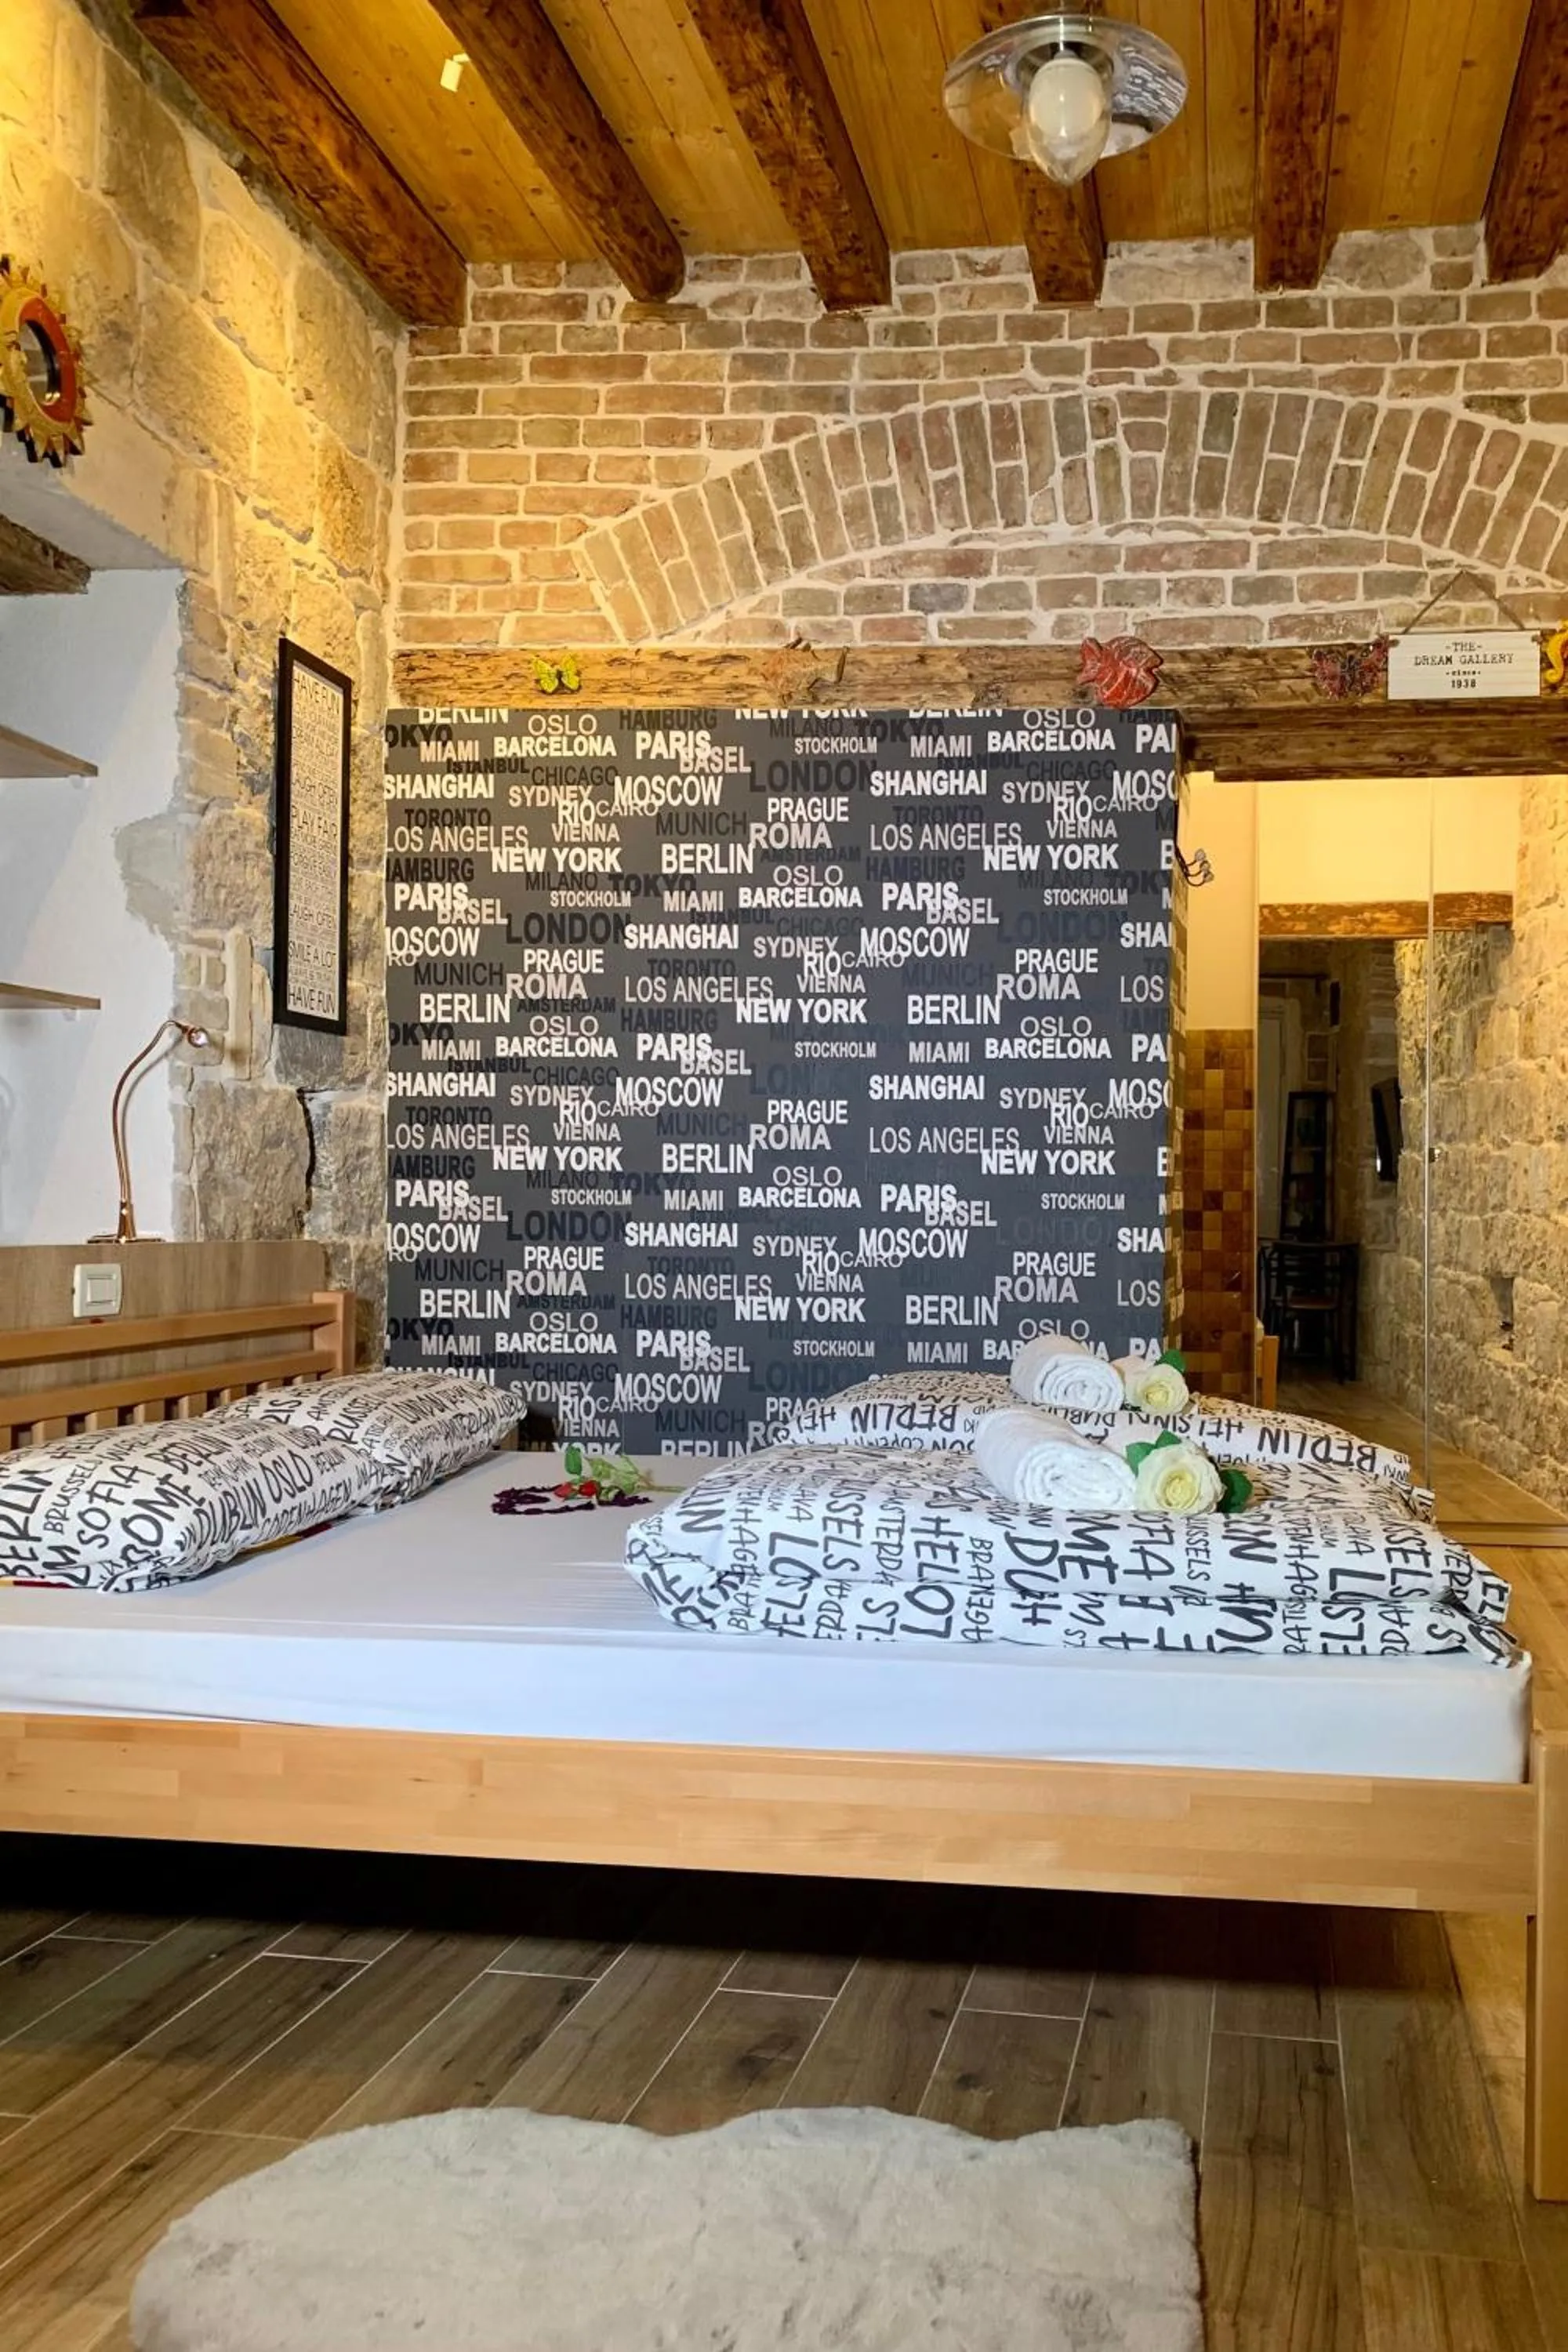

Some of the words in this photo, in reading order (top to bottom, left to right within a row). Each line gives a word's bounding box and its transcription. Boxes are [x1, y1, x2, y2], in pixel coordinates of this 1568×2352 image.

[1414, 655, 1453, 666] DREAM
[1459, 653, 1514, 664] GALLERY
[1451, 679, 1476, 688] 1938
[528, 714, 597, 735] OSLO
[1024, 708, 1095, 729] OSLO
[420, 740, 479, 760] MIAMI
[495, 736, 615, 756] BARCELONA
[637, 730, 711, 758] PARIS
[796, 736, 878, 752] STOCKHOLM
[911, 735, 972, 756] MIAMI
[989, 730, 1115, 750] BARCELONA
[680, 746, 751, 772] BASEL
[383, 775, 495, 798] SHANGHAI
[532, 765, 618, 786] CHICAGO
[872, 770, 988, 793] SHANGHAI
[509, 786, 591, 806] SYDNEY
[615, 777, 722, 804] MOSCOW
[1003, 781, 1089, 801] SYDNEY
[558, 802, 596, 824] RIO
[597, 800, 658, 815] CAIRO
[768, 796, 850, 819] PRAGUE
[1054, 798, 1094, 820] RIO
[1094, 797, 1158, 811] CAIRO
[405, 808, 490, 827] TORONTO
[656, 812, 746, 834] MUNICH
[1047, 819, 1117, 837] VIENNA
[552, 823, 619, 841] VIENNA
[751, 822, 833, 845] ROMA
[872, 824, 916, 848] LOS
[922, 823, 1023, 848] ANGELES
[492, 848, 545, 871] NEW
[553, 848, 622, 871] YORK
[662, 844, 753, 872] BERLIN
[985, 844, 1040, 868] NEW
[1047, 844, 1120, 868] YORK
[525, 872, 597, 890] MILANO
[773, 864, 843, 885] OSLO
[395, 884, 468, 911] PARIS
[550, 891, 631, 906] STOCKHOLM
[663, 889, 722, 910] MIAMI
[739, 885, 862, 906] BARCELONA
[883, 880, 959, 909] PARIS
[1045, 887, 1129, 904] STOCKHOLM
[437, 899, 507, 925] BASEL
[927, 897, 1000, 924] BASEL
[625, 924, 739, 948] SHANGHAI
[753, 935, 837, 956] SYDNEY
[860, 927, 969, 956] MOSCOW
[288, 940, 311, 963] SMILE
[313, 947, 320, 964] A
[321, 949, 336, 967] LOT
[524, 949, 604, 972] PRAGUE
[803, 952, 841, 975] RIO
[842, 951, 905, 966] CAIRO
[1017, 947, 1099, 971] PRAGUE
[414, 964, 503, 985] MUNICH
[507, 973, 587, 997] ROMA
[797, 973, 865, 991] VIENNA
[999, 972, 1082, 997] ROMA
[625, 976, 668, 1000] LOS
[674, 976, 773, 1000] ANGELES
[1122, 975, 1166, 1000] LOS
[288, 984, 314, 1010] HAVE
[318, 989, 336, 1014] FUN
[420, 994, 509, 1023] BERLIN
[517, 997, 615, 1011] AMSTERDAM
[735, 997, 789, 1021] NEW
[797, 997, 867, 1022] YORK
[908, 994, 1000, 1023] BERLIN
[528, 1015, 597, 1036] OSLO
[621, 1007, 717, 1031] HAMBURG
[1021, 1015, 1092, 1037] OSLO
[422, 1039, 480, 1060] MIAMI
[495, 1036, 615, 1057] BARCELONA
[636, 1032, 710, 1061] PARIS
[794, 1040, 877, 1056] STOCKHOLM
[909, 1040, 969, 1061] MIAMI
[986, 1036, 1111, 1058] BARCELONA
[679, 1049, 750, 1075] BASEL
[384, 1073, 495, 1097] SHANGHAI
[532, 1065, 618, 1086] CHICAGO
[870, 1075, 985, 1098] SHANGHAI
[509, 1085, 591, 1105] SYDNEY
[615, 1077, 721, 1106] MOSCOW
[1000, 1087, 1085, 1108] SYDNEY
[558, 1102, 596, 1124] RIO
[597, 1101, 658, 1116] CAIRO
[767, 1098, 848, 1123] PRAGUE
[1051, 1104, 1090, 1127] RIO
[1091, 1103, 1154, 1118] CAIRO
[553, 1123, 619, 1141] VIENNA
[750, 1123, 831, 1148] ROMA
[869, 1127, 913, 1152] LOS
[920, 1127, 1020, 1152] ANGELES
[1044, 1125, 1114, 1143] VIENNA
[492, 1146, 546, 1169] NEW
[553, 1147, 622, 1170] YORK
[662, 1144, 752, 1173] BERLIN
[982, 1149, 1036, 1172] NEW
[1044, 1149, 1116, 1174] YORK
[771, 1166, 841, 1187] OSLO
[396, 1180, 469, 1207] PARIS
[551, 1189, 631, 1204] STOCKHOLM
[662, 1189, 721, 1210] MIAMI
[738, 1186, 860, 1207] BARCELONA
[881, 1183, 956, 1211] PARIS
[1042, 1192, 1125, 1209] STOCKHOLM
[438, 1196, 507, 1221] BASEL
[924, 1200, 996, 1226] BASEL
[625, 1223, 738, 1247] SHANGHAI
[751, 1235, 835, 1256] SYDNEY
[858, 1229, 967, 1258] MOSCOW
[524, 1246, 604, 1269] PRAGUE
[801, 1253, 840, 1275] RIO
[840, 1252, 902, 1267] CAIRO
[1014, 1250, 1096, 1275] PRAGUE
[416, 1260, 503, 1281] MUNICH
[507, 1270, 587, 1294] ROMA
[625, 1275, 667, 1298] LOS
[673, 1275, 771, 1299] ANGELES
[795, 1274, 863, 1291] VIENNA
[996, 1276, 1079, 1300] ROMA
[1118, 1280, 1162, 1304] LOS
[422, 1290, 510, 1318] BERLIN
[735, 1297, 788, 1319] NEW
[796, 1298, 865, 1321] YORK
[906, 1295, 997, 1324] BERLIN
[529, 1312, 597, 1333] OSLO
[423, 1334, 481, 1354] MIAMI
[496, 1332, 615, 1353] BARCELONA
[636, 1330, 710, 1358] PARIS
[793, 1340, 874, 1356] STOCKHOLM
[907, 1341, 967, 1362] MIAMI
[679, 1347, 749, 1372] BASEL
[510, 1380, 591, 1401] SYDNEY
[614, 1374, 720, 1403] MOSCOW
[558, 1398, 596, 1419] RIO
[597, 1397, 657, 1412] CAIRO
[259, 1449, 314, 1504] OSLO
[77, 1461, 157, 1549] SOFIA
[194, 1475, 268, 1551] DUBLIN
